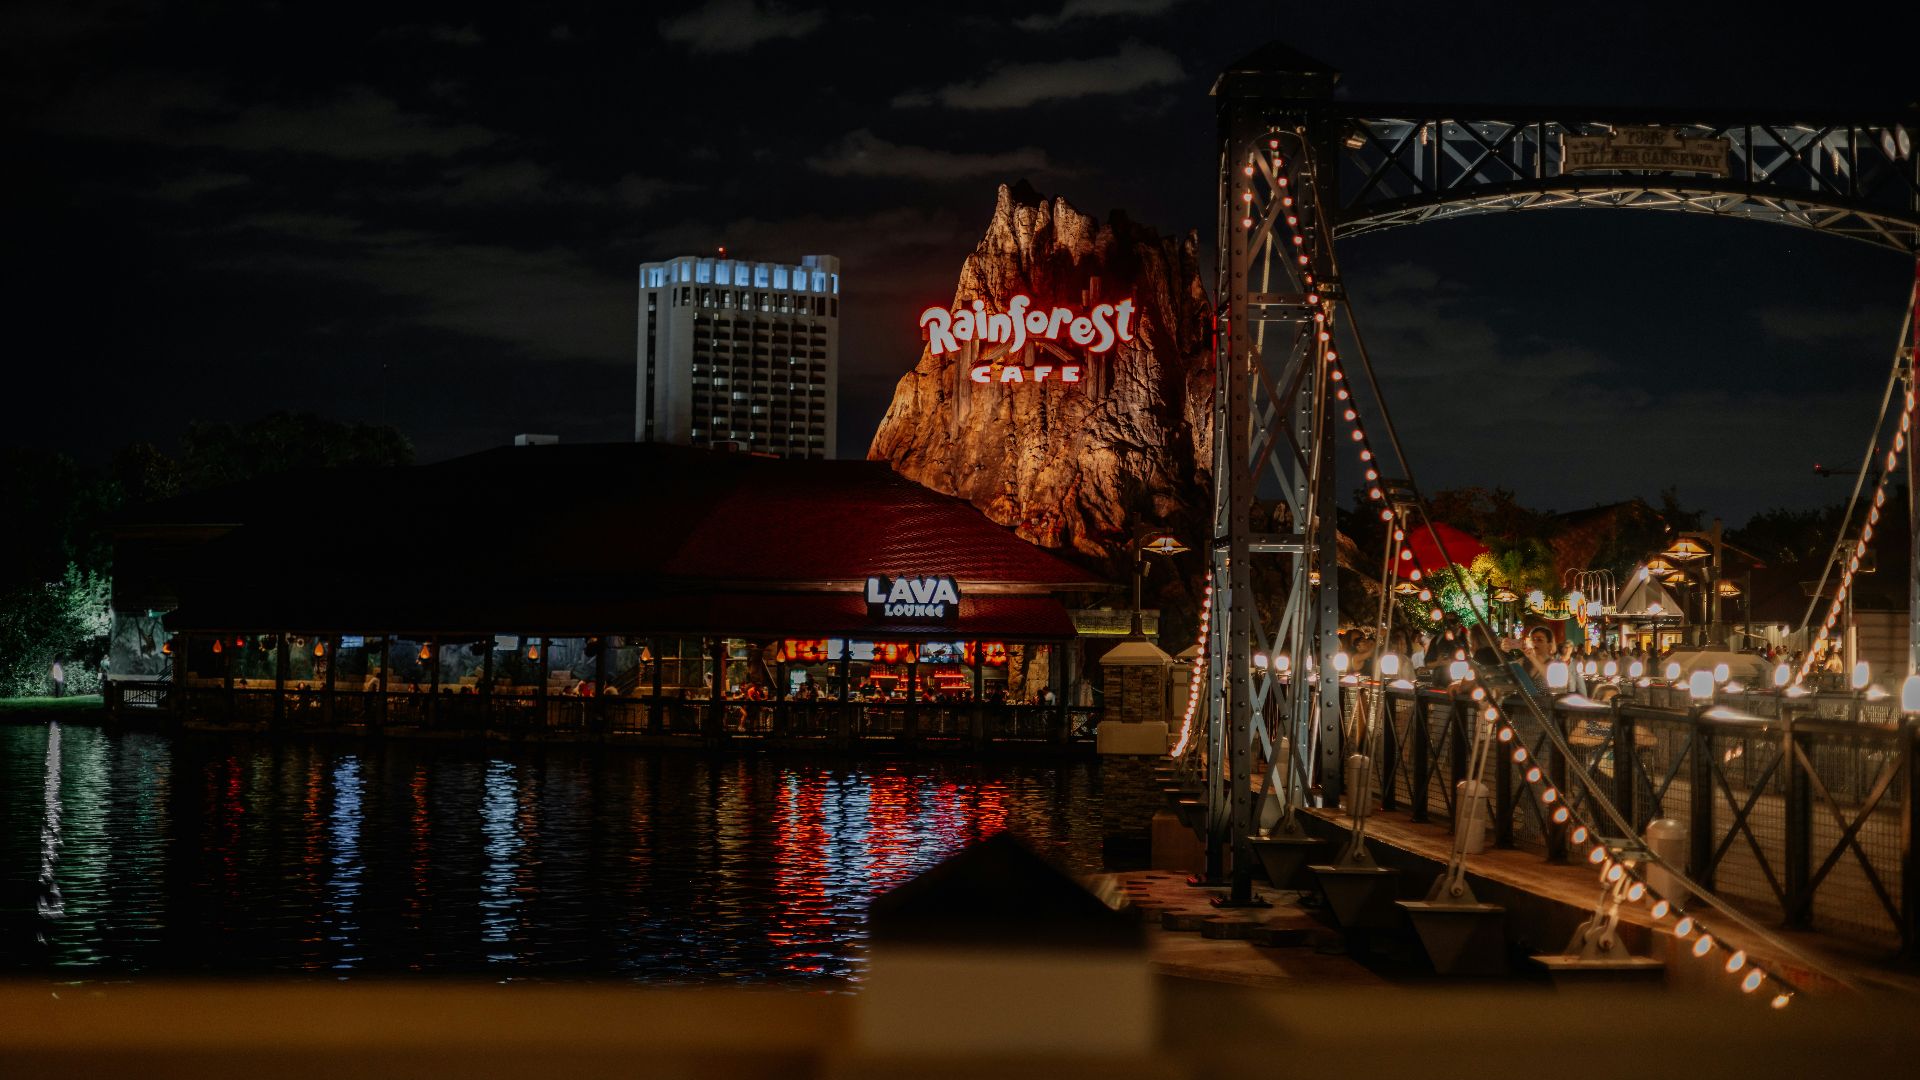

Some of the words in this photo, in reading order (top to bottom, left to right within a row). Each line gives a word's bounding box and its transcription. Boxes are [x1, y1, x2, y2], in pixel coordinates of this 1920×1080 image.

[1642, 151, 1721, 168] CAUSEWAY
[920, 294, 1136, 355] Rainforest
[970, 366, 1080, 383] CAFE
[867, 577, 959, 604] LAVA
[884, 604, 945, 618] LOUNGE
